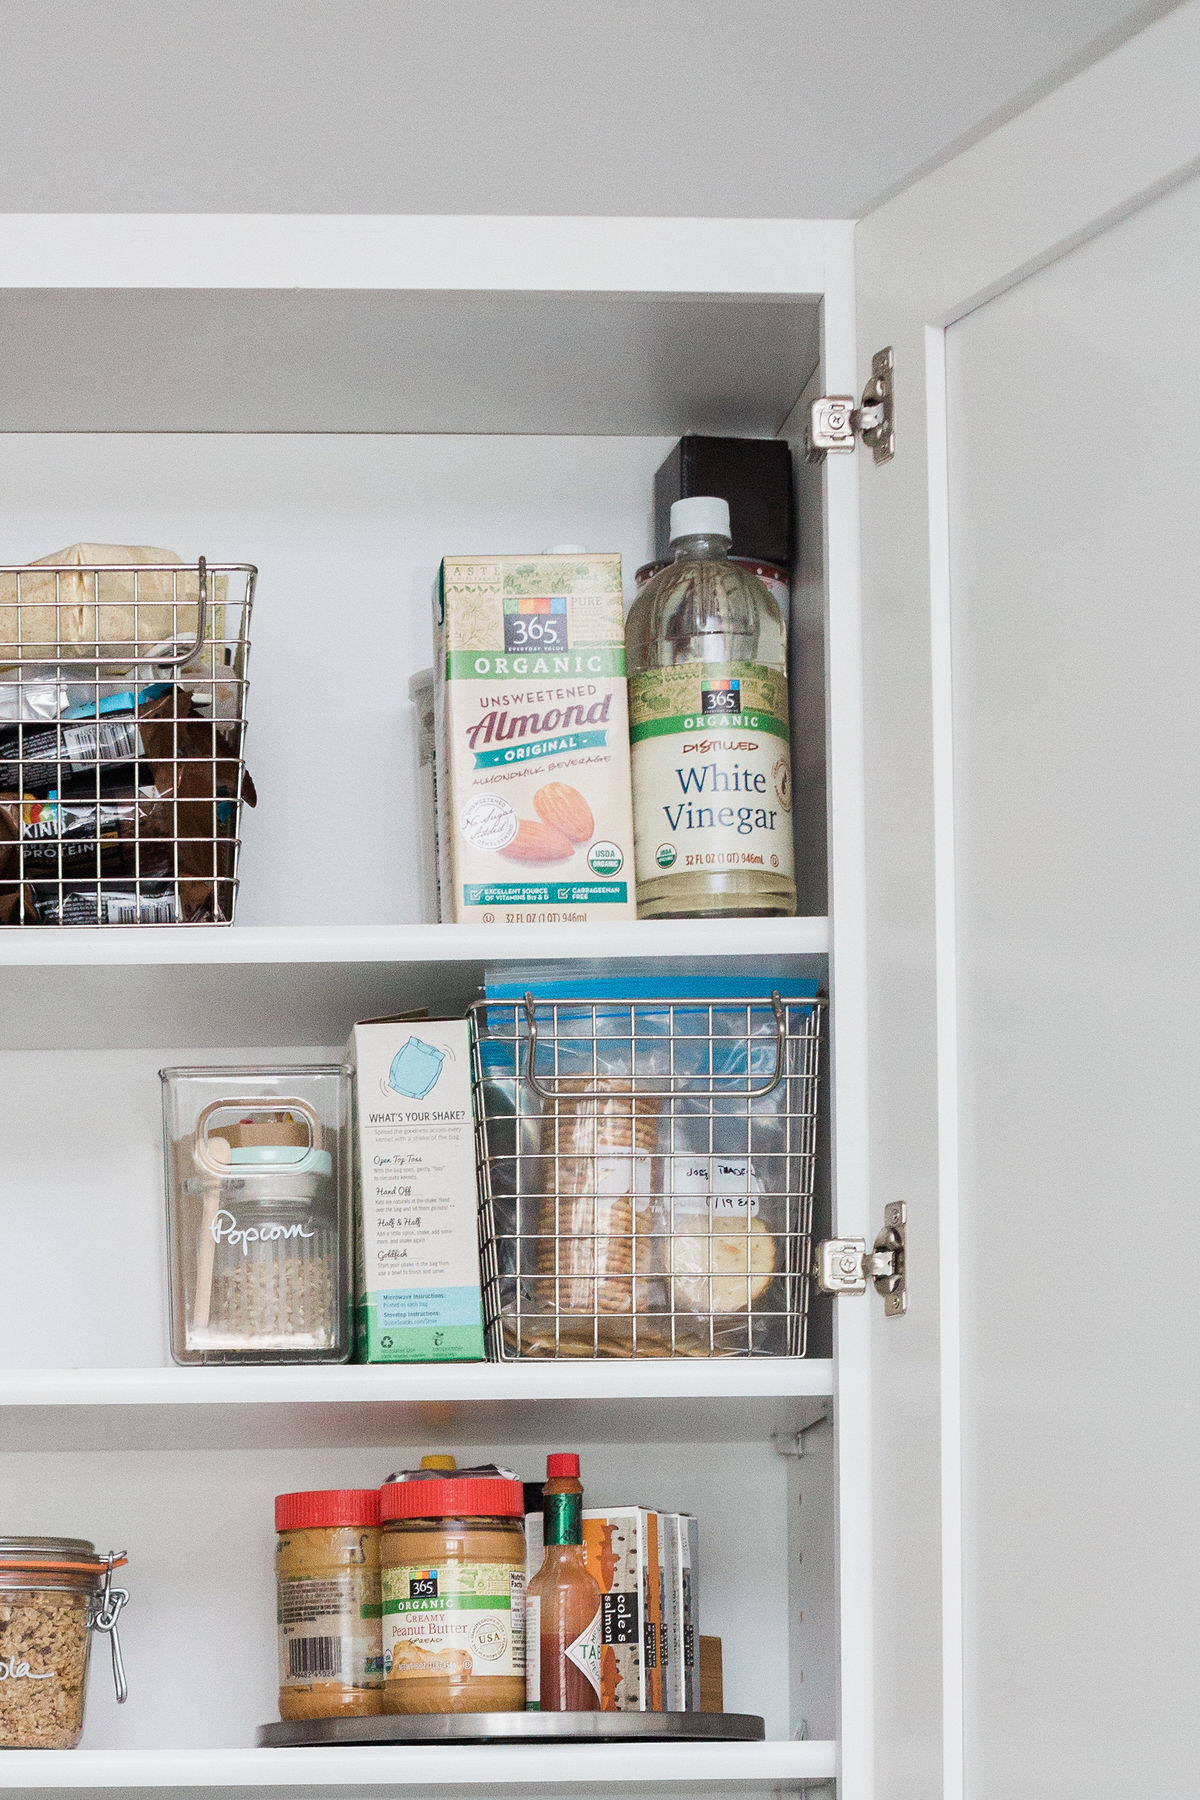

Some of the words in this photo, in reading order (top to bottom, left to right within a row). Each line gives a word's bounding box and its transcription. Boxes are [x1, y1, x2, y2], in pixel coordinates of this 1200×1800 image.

[512, 616, 559, 645] 365
[474, 656, 601, 675] ORGANIC
[480, 684, 597, 708] UNSWEETENED
[707, 691, 735, 709] 365
[465, 693, 613, 750] Almond
[683, 716, 759, 728] ORGANIC
[504, 737, 578, 762] ORIGINAL
[547, 754, 612, 772] BEVERAGE
[675, 763, 767, 794] White
[662, 801, 778, 835] Vinegar
[22, 843, 95, 859] PROTEIN
[595, 850, 616, 858] USDA
[685, 855, 695, 866] 32
[695, 855, 704, 865] FL
[705, 854, 716, 864] OZ
[368, 1112, 403, 1123] WHAT'S
[405, 1111, 430, 1122] YOUR
[432, 1110, 466, 1121] SHAKE?
[373, 1155, 392, 1166] Open
[376, 1186, 397, 1196] Hand
[412, 1579, 435, 1596] 365
[398, 1599, 455, 1611] ORGANIC
[405, 1613, 446, 1624] CREAMY
[604, 1595, 614, 1644] salmon
[617, 1594, 632, 1642] cole's
[391, 1622, 426, 1638] Peanut
[428, 1620, 469, 1635] Butter
[478, 1632, 501, 1645] USA
